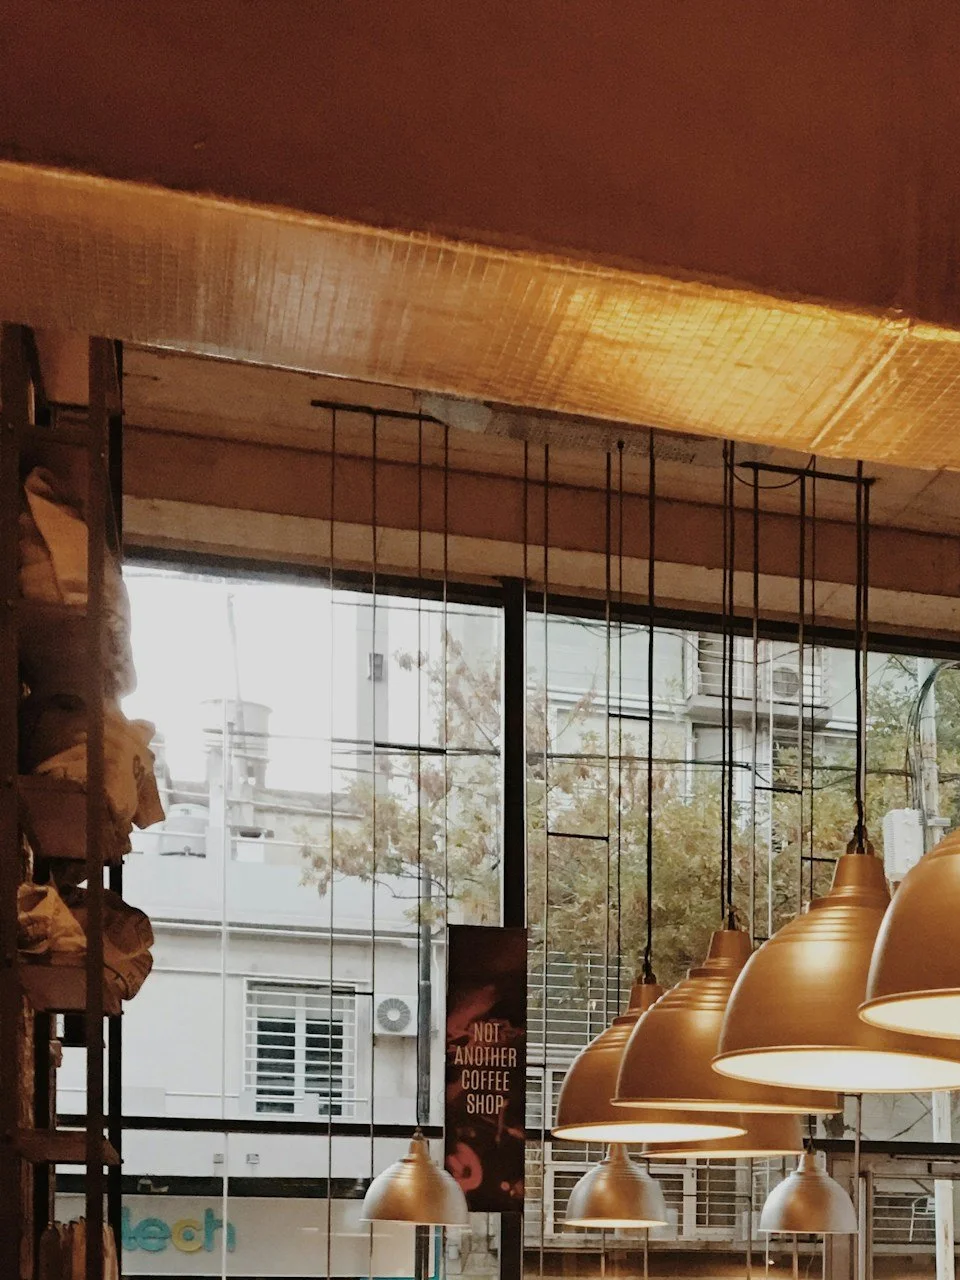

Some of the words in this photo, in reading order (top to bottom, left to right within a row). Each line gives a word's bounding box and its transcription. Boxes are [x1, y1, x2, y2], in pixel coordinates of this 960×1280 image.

[473, 1022, 500, 1043] NOT
[454, 1045, 517, 1068] ANOTHER
[461, 1069, 510, 1091] COFFEE
[466, 1093, 504, 1115] SHOP
